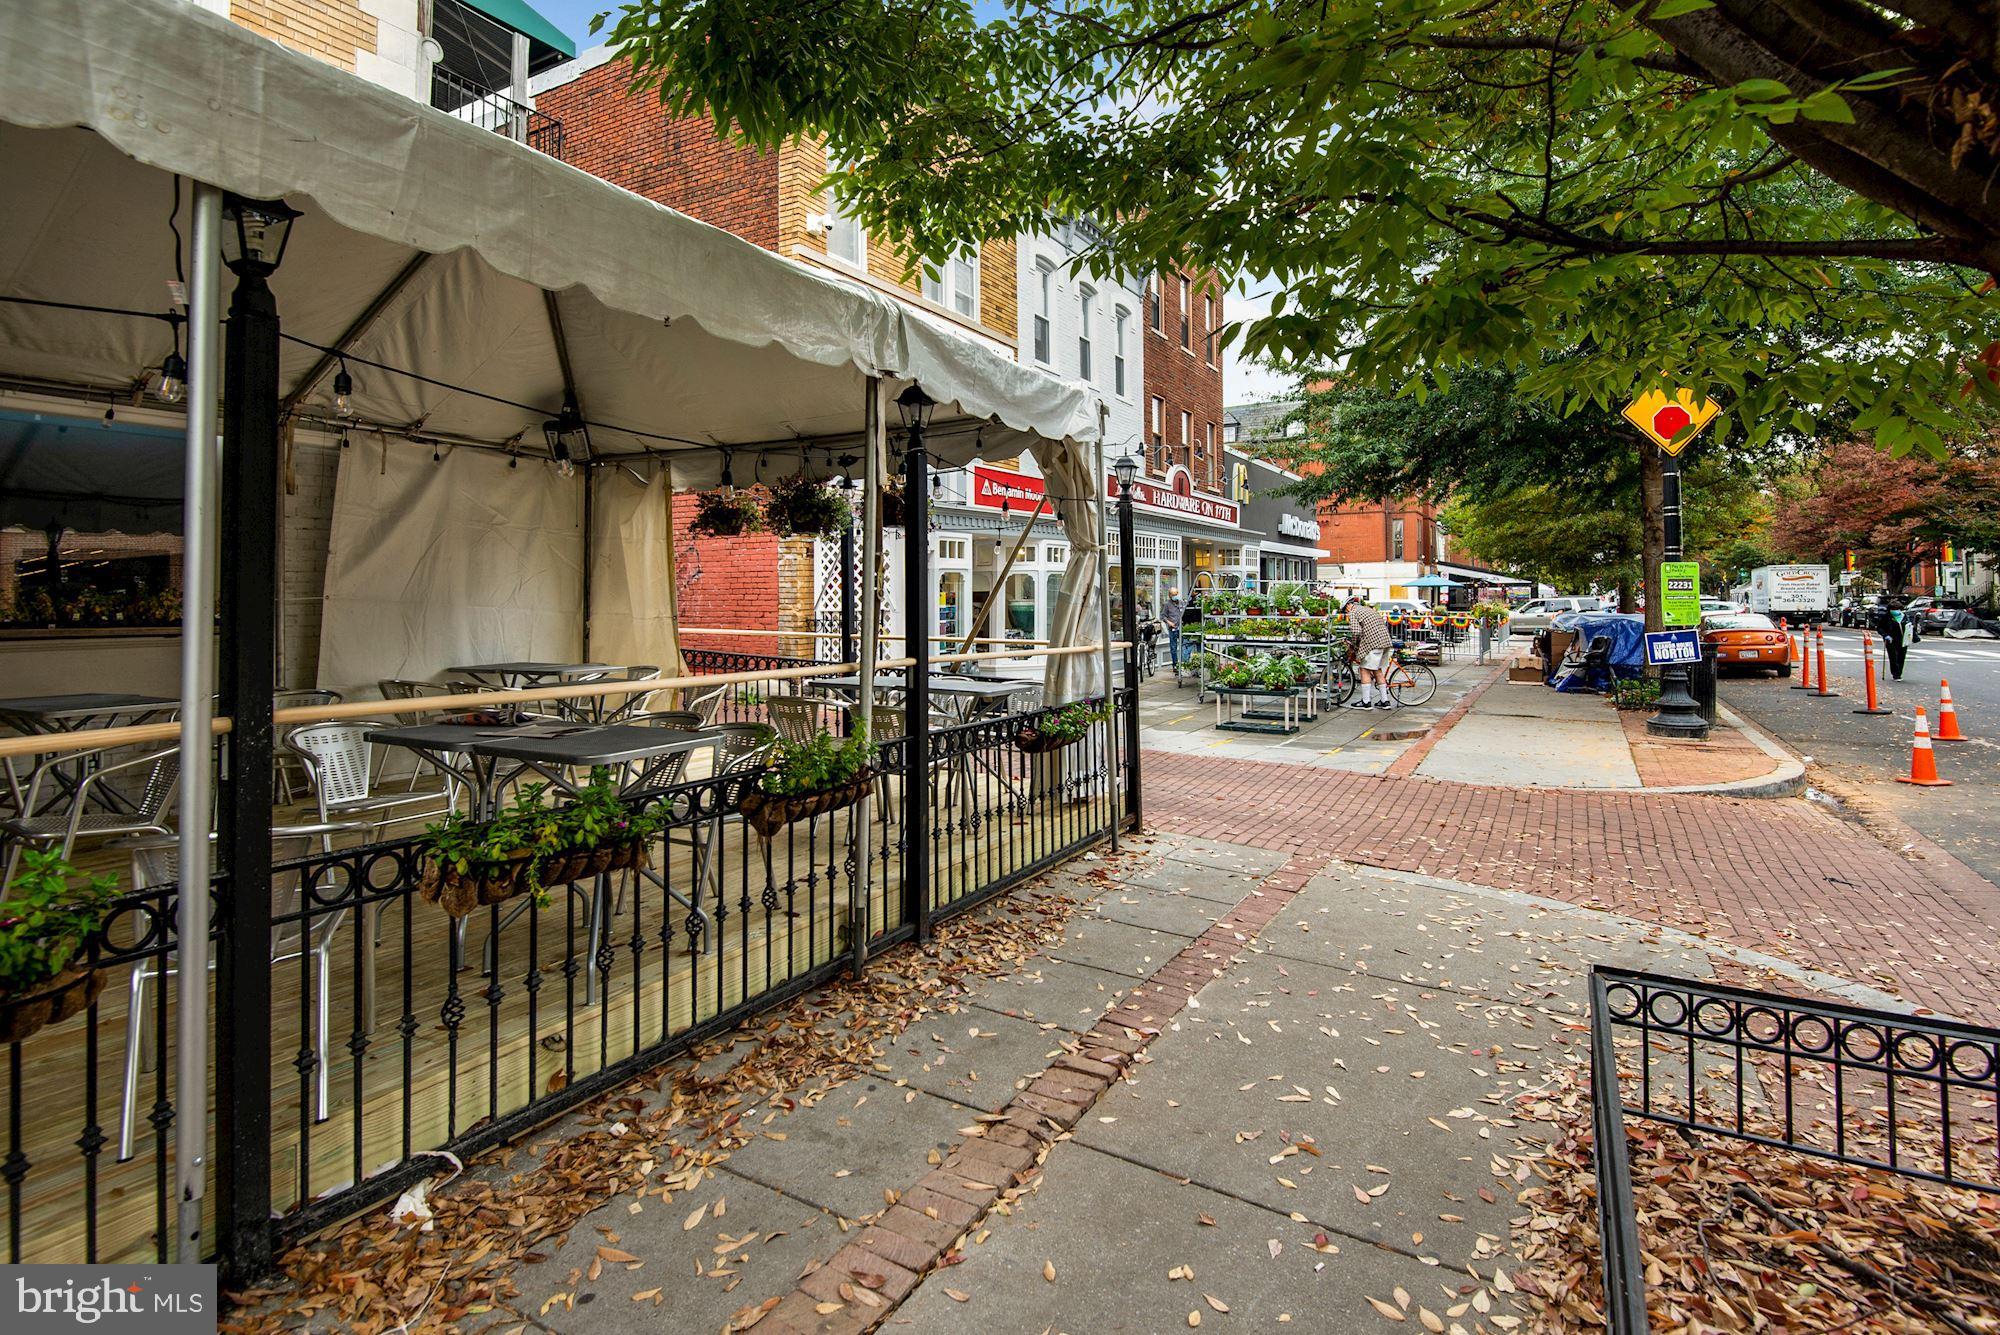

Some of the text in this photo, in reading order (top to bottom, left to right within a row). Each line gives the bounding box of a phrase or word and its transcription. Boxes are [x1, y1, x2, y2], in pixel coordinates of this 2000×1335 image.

[1152, 489, 1200, 513] HARDWARE
[1201, 501, 1214, 517] ON
[1215, 505, 1232, 520] 17TH
[1668, 581, 1693, 589] 22231
[1654, 647, 1695, 660] NORTON
